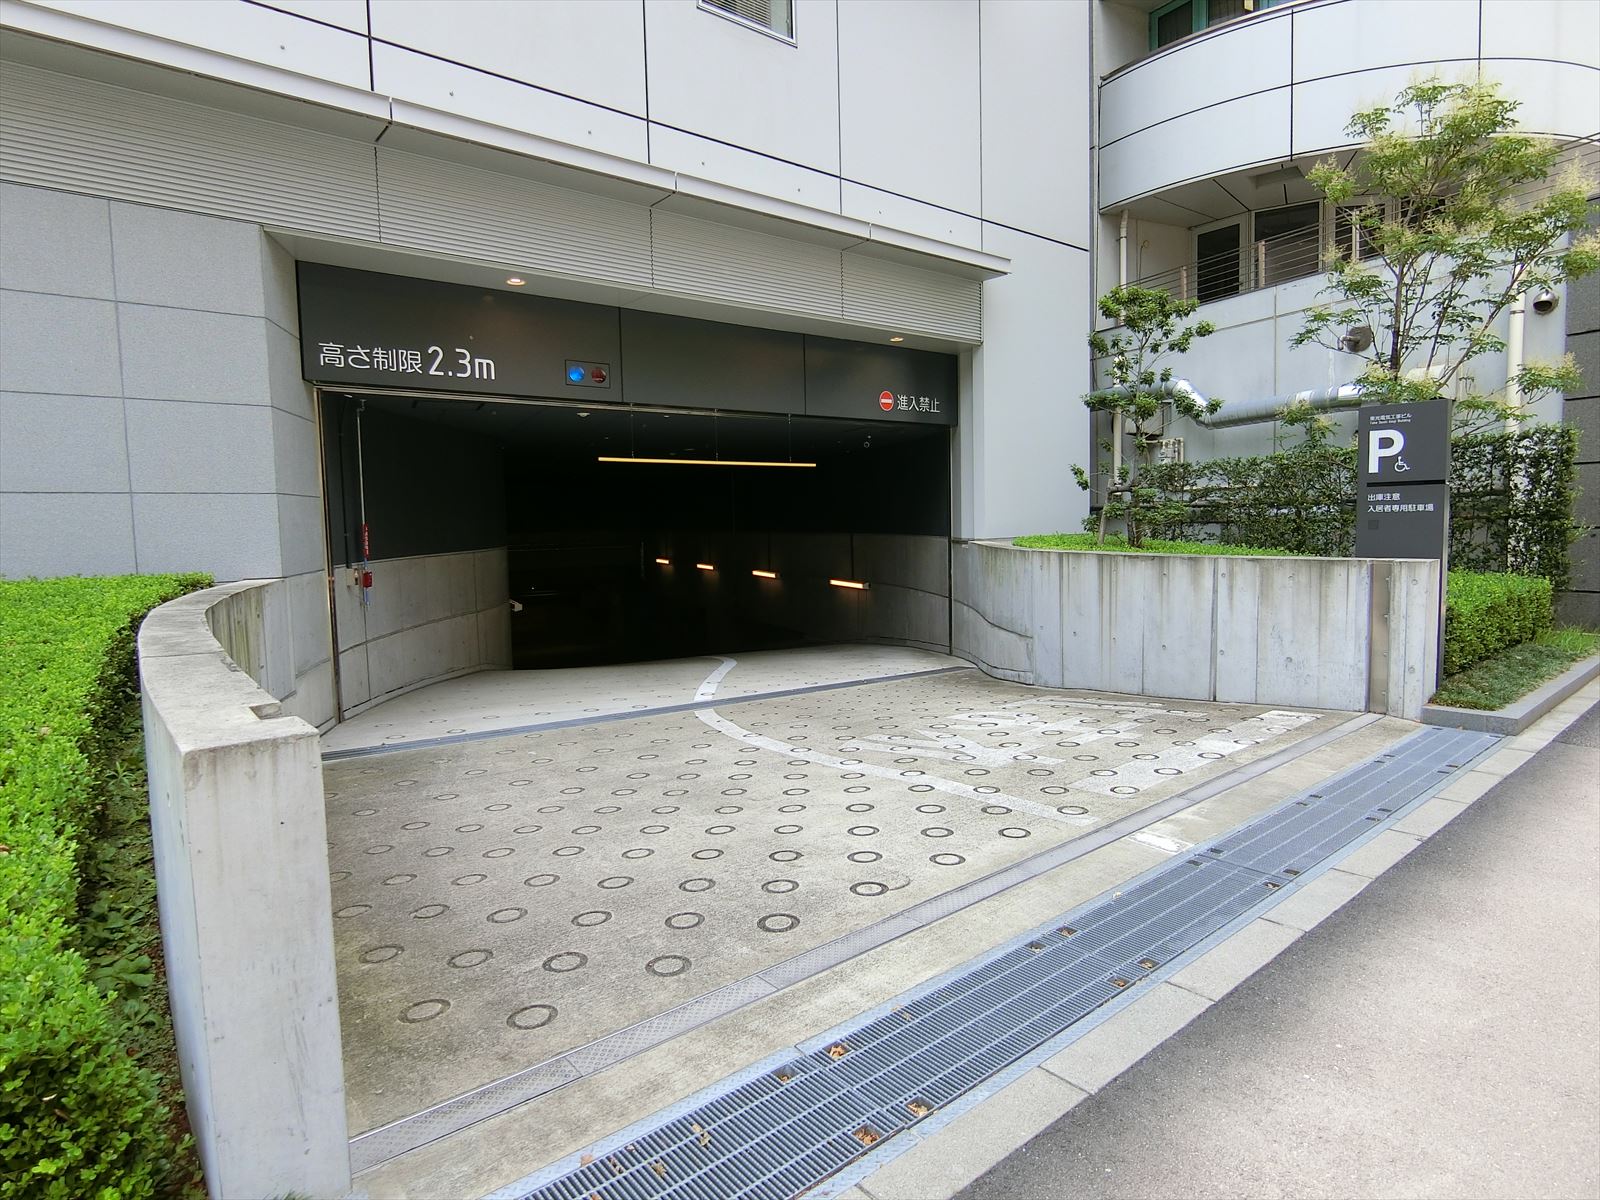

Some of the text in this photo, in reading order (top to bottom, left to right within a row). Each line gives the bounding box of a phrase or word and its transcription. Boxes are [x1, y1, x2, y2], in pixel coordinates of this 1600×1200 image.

[318, 342, 496, 380] 高さ制限 2.3m
[897, 395, 940, 412] 進入禁止
[1368, 429, 1405, 474] P
